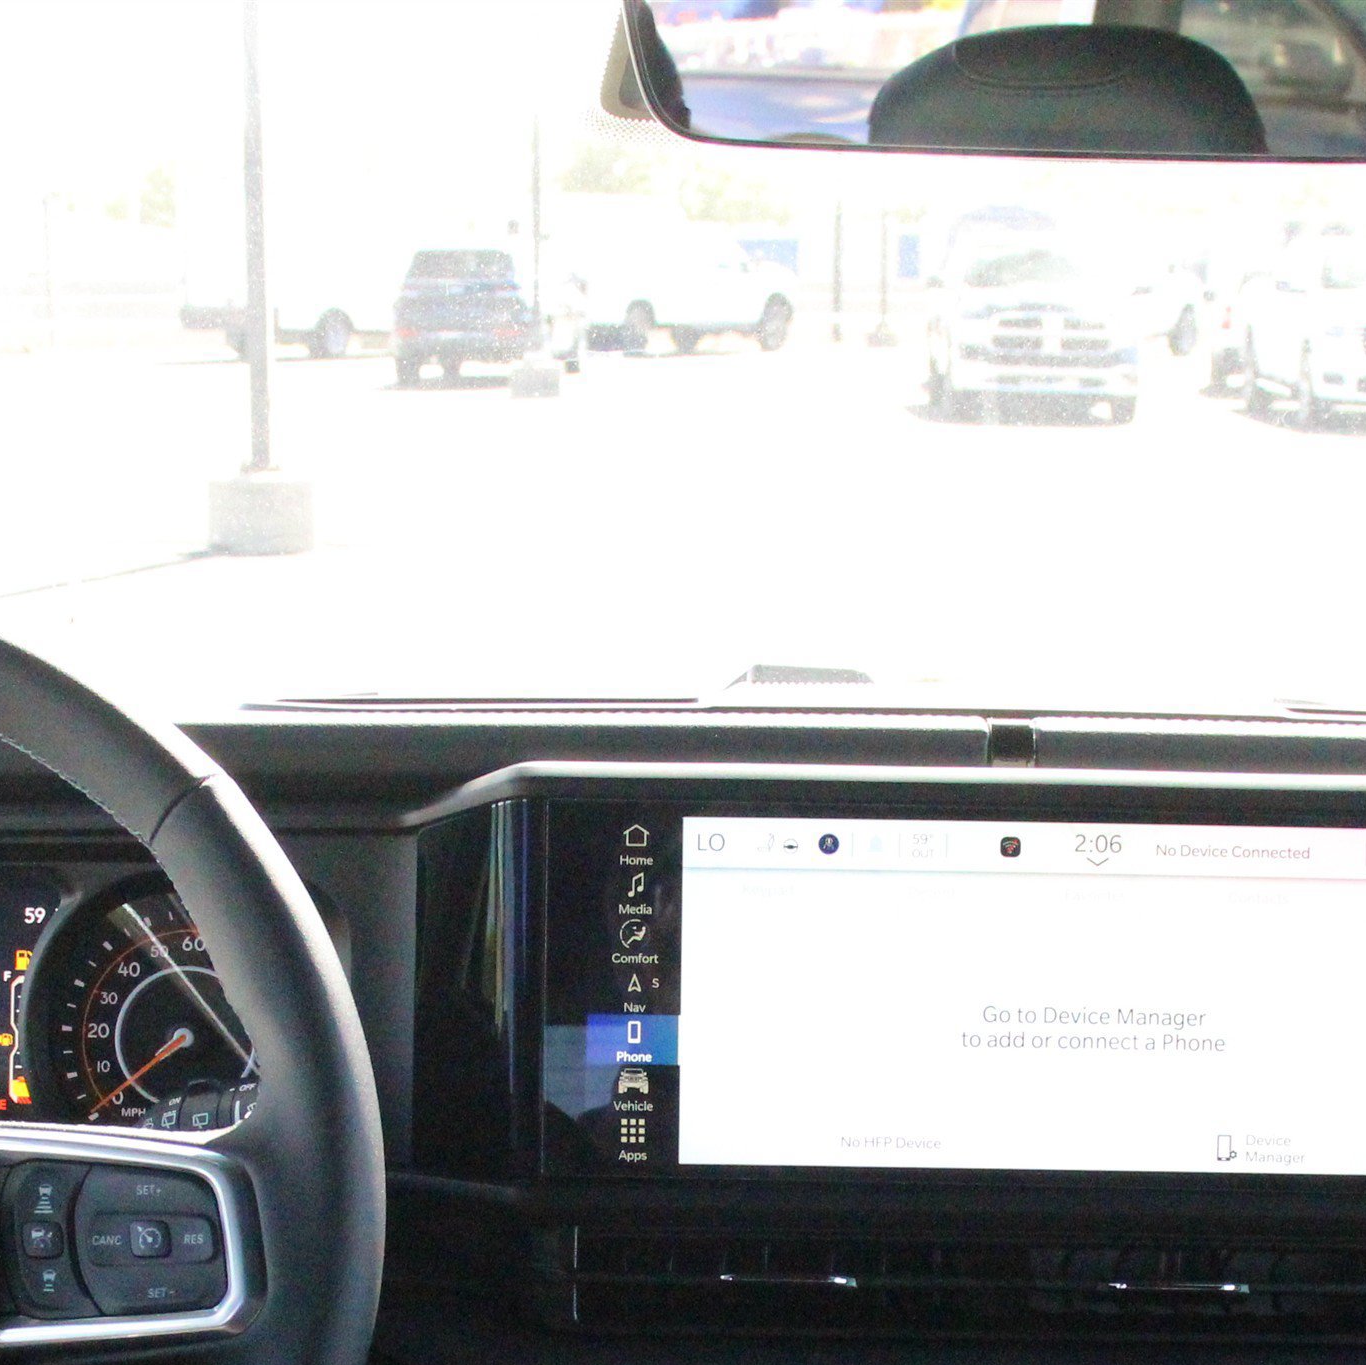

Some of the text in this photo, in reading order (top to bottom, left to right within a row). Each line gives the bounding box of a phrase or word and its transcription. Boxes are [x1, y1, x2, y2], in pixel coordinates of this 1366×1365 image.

[696, 834, 725, 852] LO
[1075, 833, 1123, 855] 2:06
[1156, 844, 1311, 860] No Device Connected
[619, 855, 654, 866] Home
[618, 904, 653, 915] Media
[150, 946, 168, 958] 50
[611, 953, 659, 964] Comfort
[3, 970, 12, 981] F
[118, 962, 141, 977] 40
[651, 978, 660, 988] S
[100, 992, 118, 1005] 30
[623, 1003, 646, 1013] Nav
[983, 1006, 1206, 1030] Go to Device Manager
[88, 1023, 110, 1038] 20
[962, 1032, 1225, 1052] to add or connect a Phone
[616, 1051, 653, 1062] Phone
[97, 1061, 110, 1073] 10
[121, 1107, 146, 1117] MPH
[613, 1101, 654, 1111] Vehicle
[841, 1137, 860, 1147] No
[896, 1137, 941, 1149] Device
[1246, 1135, 1291, 1146] Device
[618, 1150, 648, 1162] Apps
[1245, 1152, 1304, 1166] Manager
[91, 1234, 122, 1246] CANC
[183, 1234, 204, 1246] RES
